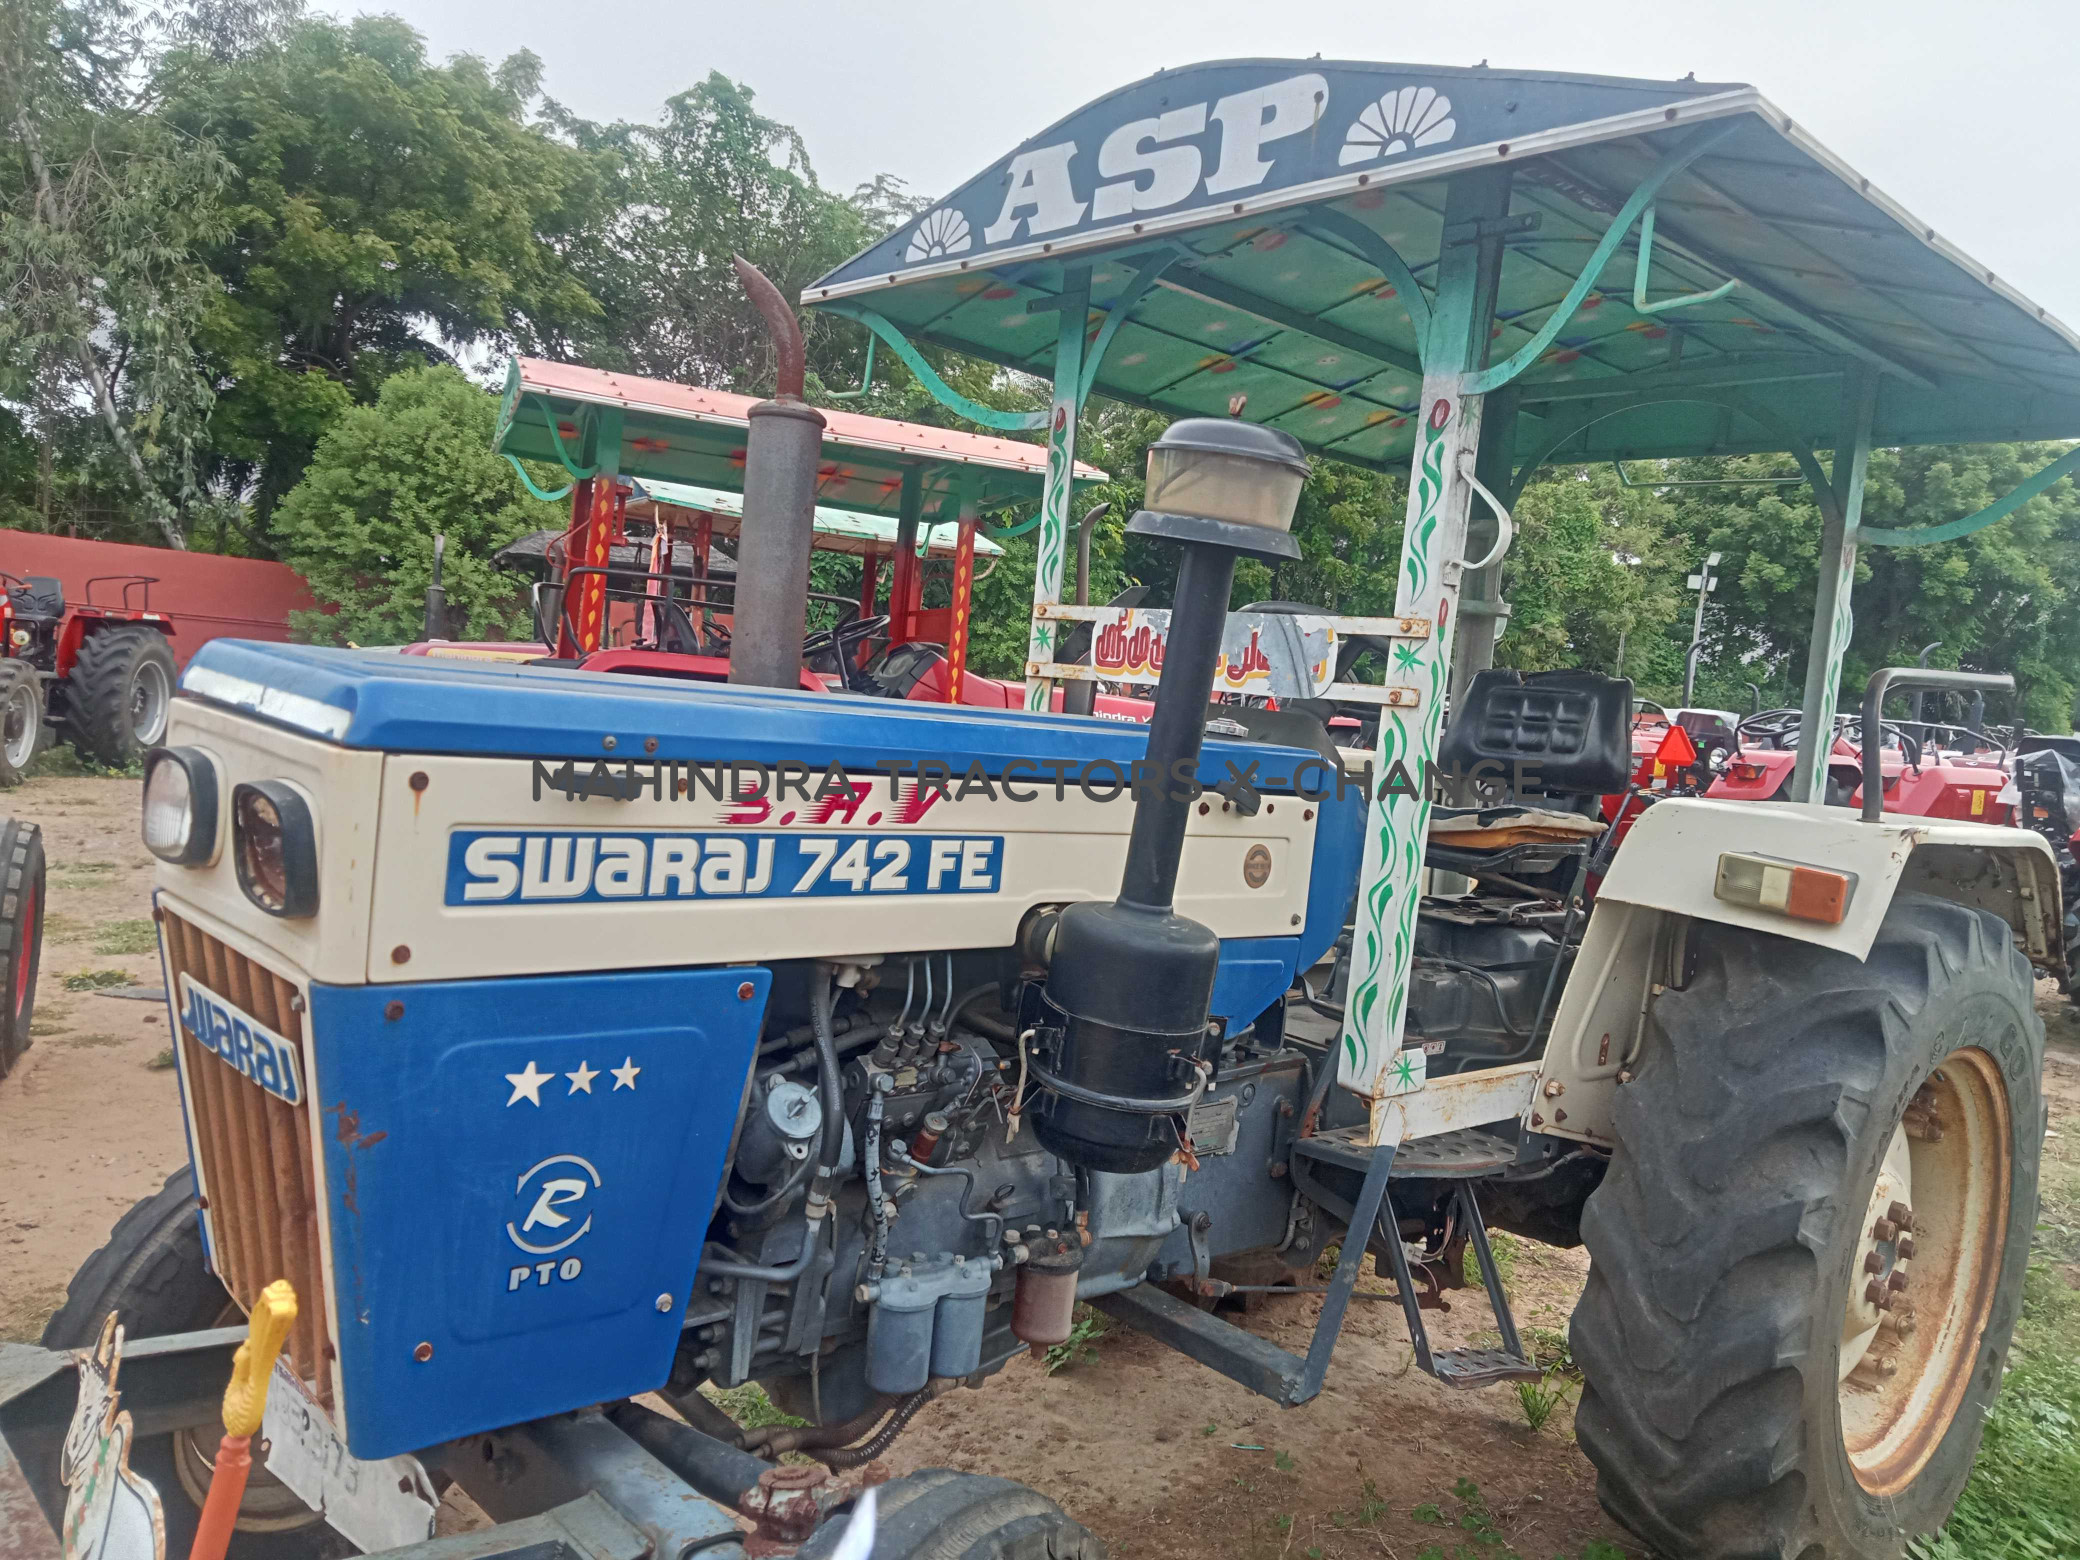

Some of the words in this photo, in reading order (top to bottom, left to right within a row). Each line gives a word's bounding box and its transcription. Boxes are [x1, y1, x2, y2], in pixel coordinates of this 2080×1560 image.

[984, 73, 1329, 244] ASP
[791, 839, 911, 893] 742
[927, 840, 994, 890] FE
[522, 1178, 587, 1232] R
[507, 1257, 582, 1291] PTO
